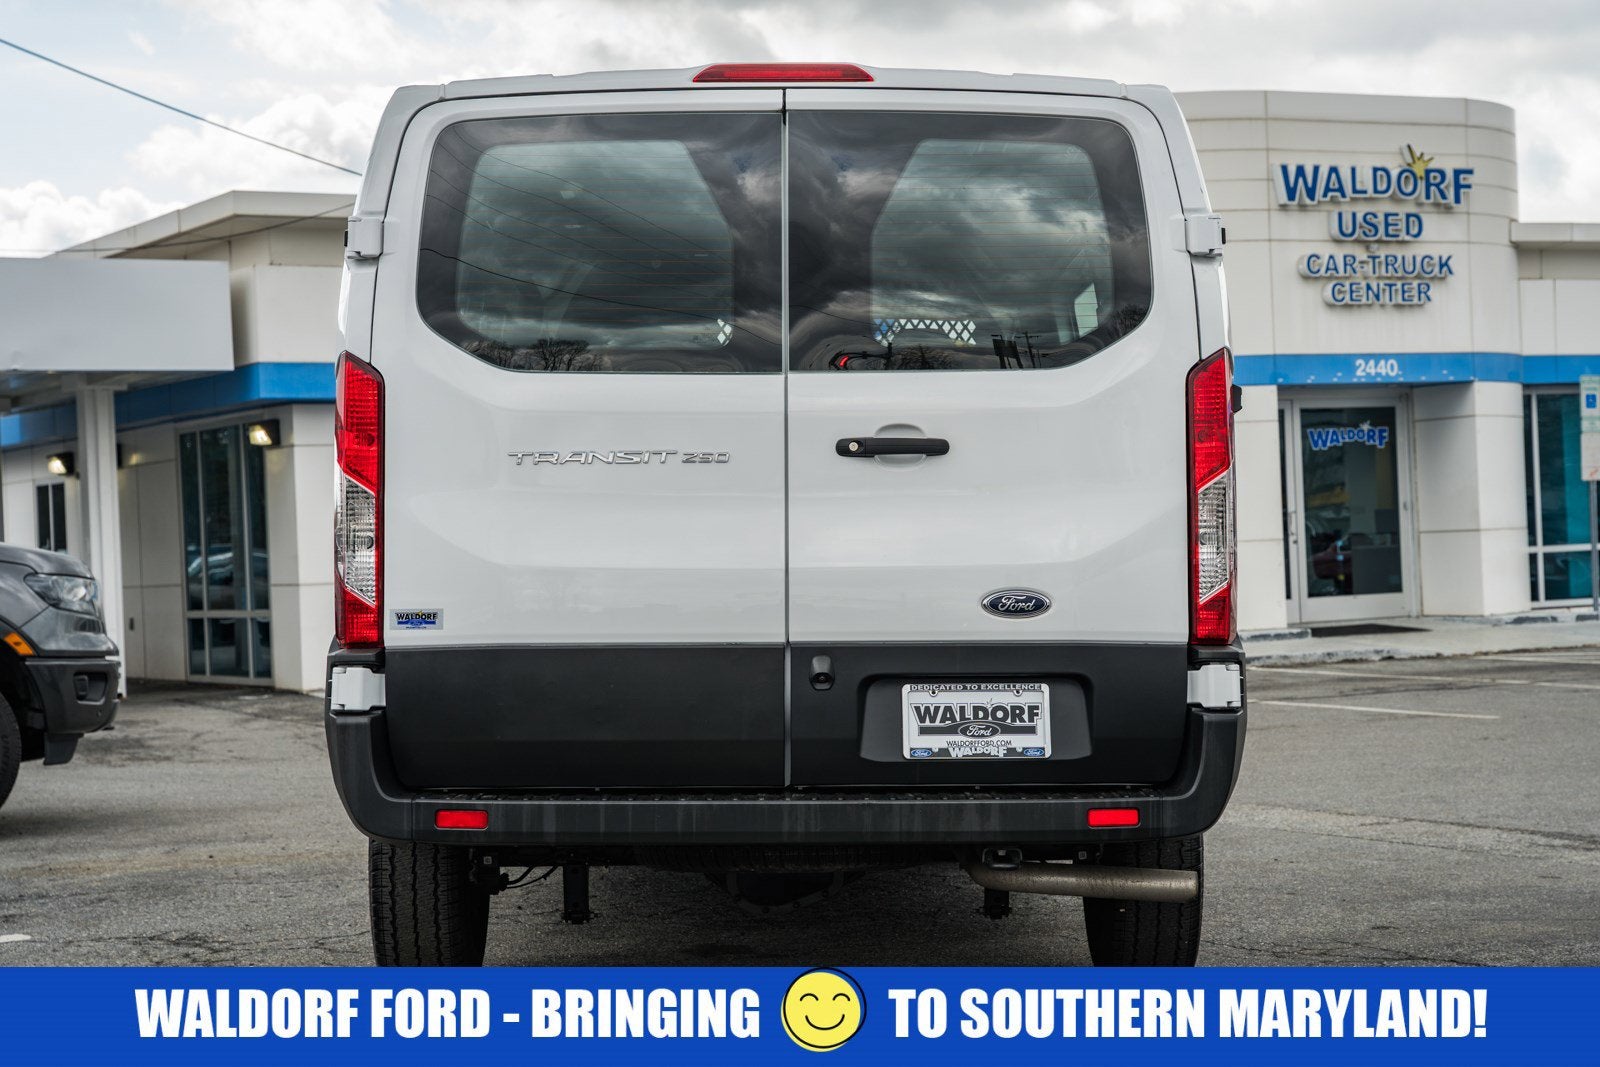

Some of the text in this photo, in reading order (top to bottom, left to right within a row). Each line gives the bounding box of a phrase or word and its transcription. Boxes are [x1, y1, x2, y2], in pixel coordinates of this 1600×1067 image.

[1280, 164, 1474, 205] WALDORF
[1337, 211, 1424, 239] USED
[1306, 253, 1454, 276] CAR-TRUCK
[1331, 282, 1432, 302] CENTER
[1355, 359, 1399, 377] 2440
[1307, 427, 1389, 451] WALDORF
[507, 450, 731, 466] TRANSIT 250
[998, 595, 1036, 611] Ford
[395, 612, 438, 620] WALDORF
[913, 704, 1040, 724] WALDORF
[966, 725, 993, 737] Ford
[946, 740, 1012, 748] WALDORFFORD.COM
[948, 747, 1008, 758] WALDORF
